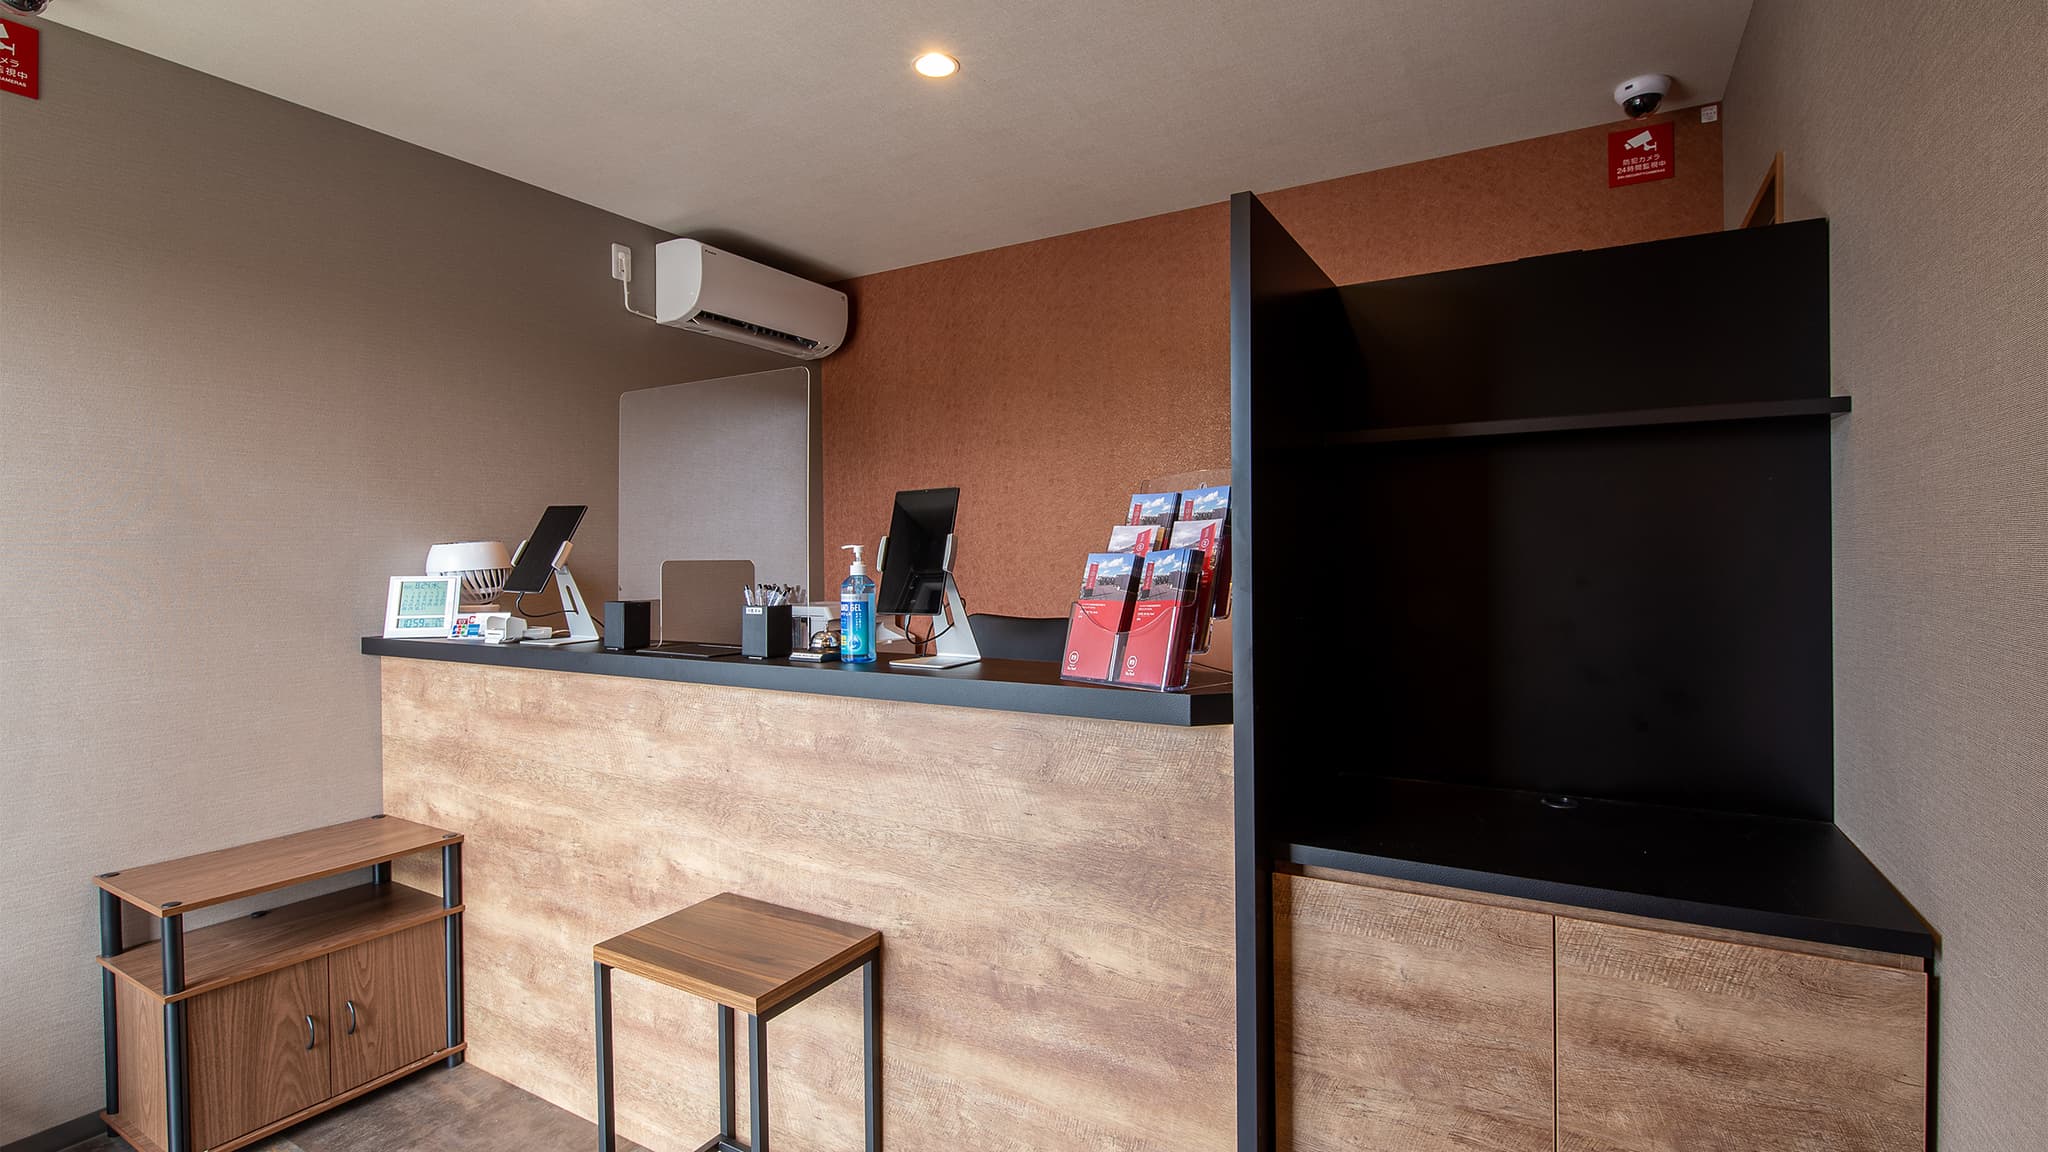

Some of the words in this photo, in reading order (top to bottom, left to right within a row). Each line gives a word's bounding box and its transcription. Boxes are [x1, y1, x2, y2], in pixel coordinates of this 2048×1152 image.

[1622, 153, 1660, 166] 防犯カメラ
[1616, 160, 1666, 175] 24時間監視中
